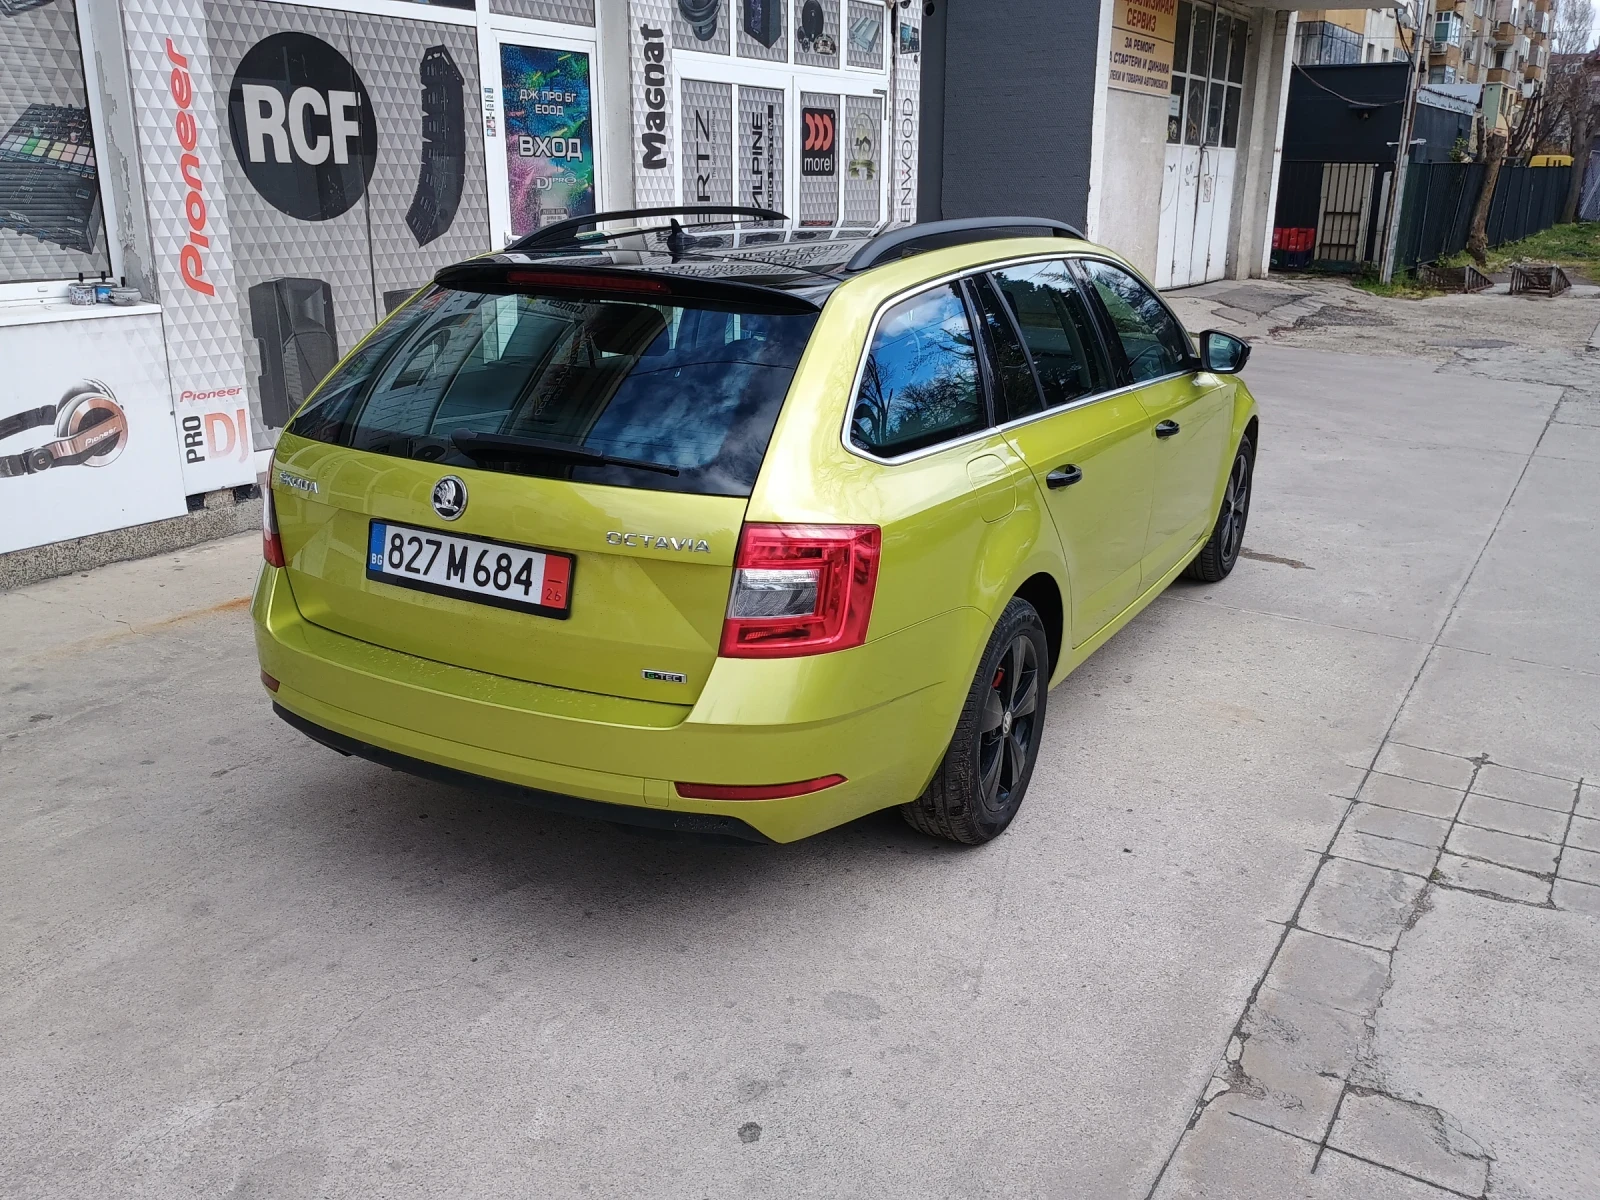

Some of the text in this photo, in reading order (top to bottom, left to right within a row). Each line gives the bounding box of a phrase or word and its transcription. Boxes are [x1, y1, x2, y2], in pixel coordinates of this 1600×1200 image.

[1126, 8, 1157, 32] СЕРВИЗ
[1124, 36, 1156, 54] ЗА РЕМОНТ
[1113, 52, 1142, 69] СТАРТЕРИ
[1142, 58, 1148, 70] И
[1147, 60, 1169, 74] ДИНАМА
[519, 88, 577, 104] ДЖ ПРО БГ
[535, 104, 565, 117] ЕООД
[241, 84, 360, 166] RCF
[518, 135, 583, 162] ВХОД
[900, 97, 914, 222] ENWOOD
[166, 37, 215, 297] Pioneer
[696, 109, 711, 222] RTZ
[804, 154, 833, 171] morel
[179, 386, 243, 403] Pioneer
[85, 427, 117, 446] Pioneer
[182, 408, 249, 464] PRO DJ
[605, 530, 712, 555] OCTAVIA
[371, 552, 383, 566] BG
[388, 532, 534, 597] 827 M 684
[545, 588, 563, 603] 26
[647, 671, 680, 683] G-TEC
